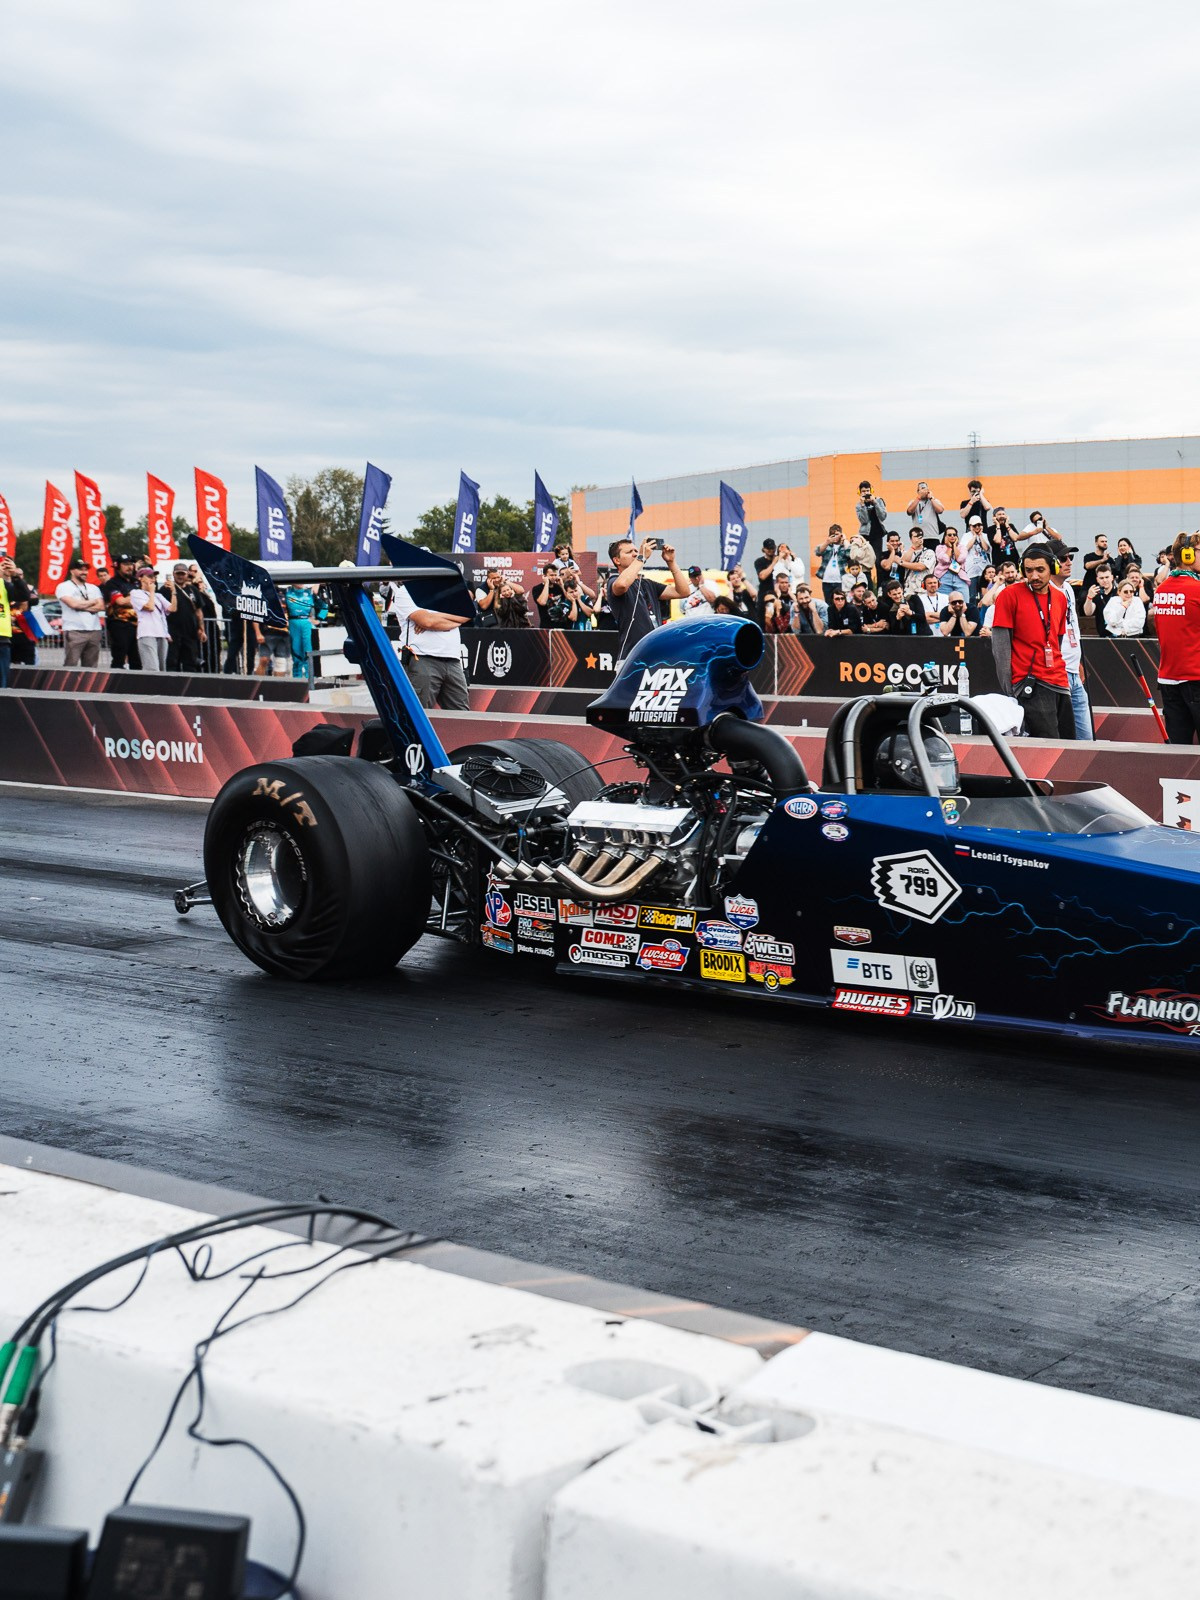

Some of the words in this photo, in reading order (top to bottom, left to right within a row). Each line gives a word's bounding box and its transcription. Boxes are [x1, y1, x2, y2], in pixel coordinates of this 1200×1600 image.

[154, 489, 171, 560] uto.ru
[203, 485, 224, 548] to.ru
[268, 506, 286, 541] ВТБ
[366, 505, 384, 542] ВТБ
[85, 486, 107, 570] auto.ru
[458, 512, 475, 547] ВТБ
[540, 511, 554, 546] ВТБ
[47, 498, 68, 581] auto.ru
[723, 522, 743, 558] ВТБ
[236, 595, 268, 617] GORILLA
[639, 668, 695, 691] MAX
[840, 661, 960, 685] ROSGOK
[628, 711, 678, 723] MOTORSPORT
[104, 737, 203, 763] ROSGONKI
[790, 802, 813, 814] NHRA
[970, 849, 1002, 862] Leonid
[1002, 854, 1050, 870] Tsygankov
[907, 866, 930, 875] RDRC
[899, 873, 939, 898] 799
[514, 893, 556, 915] JESEL
[597, 902, 638, 920] MSD
[730, 905, 755, 915] LUCAS
[518, 917, 532, 928] PRO
[652, 910, 693, 930] Racepak
[584, 930, 626, 946] COMP
[612, 943, 634, 951] CAMS
[642, 949, 669, 960] LUCAS
[668, 952, 682, 962] OIL
[754, 941, 794, 957] WELD
[756, 953, 793, 962] RACING
[703, 952, 743, 973] BRODIX
[861, 962, 893, 980] ВТБ
[834, 1003, 905, 1015] CONVERTERS
[836, 991, 910, 1010] HUGHES
